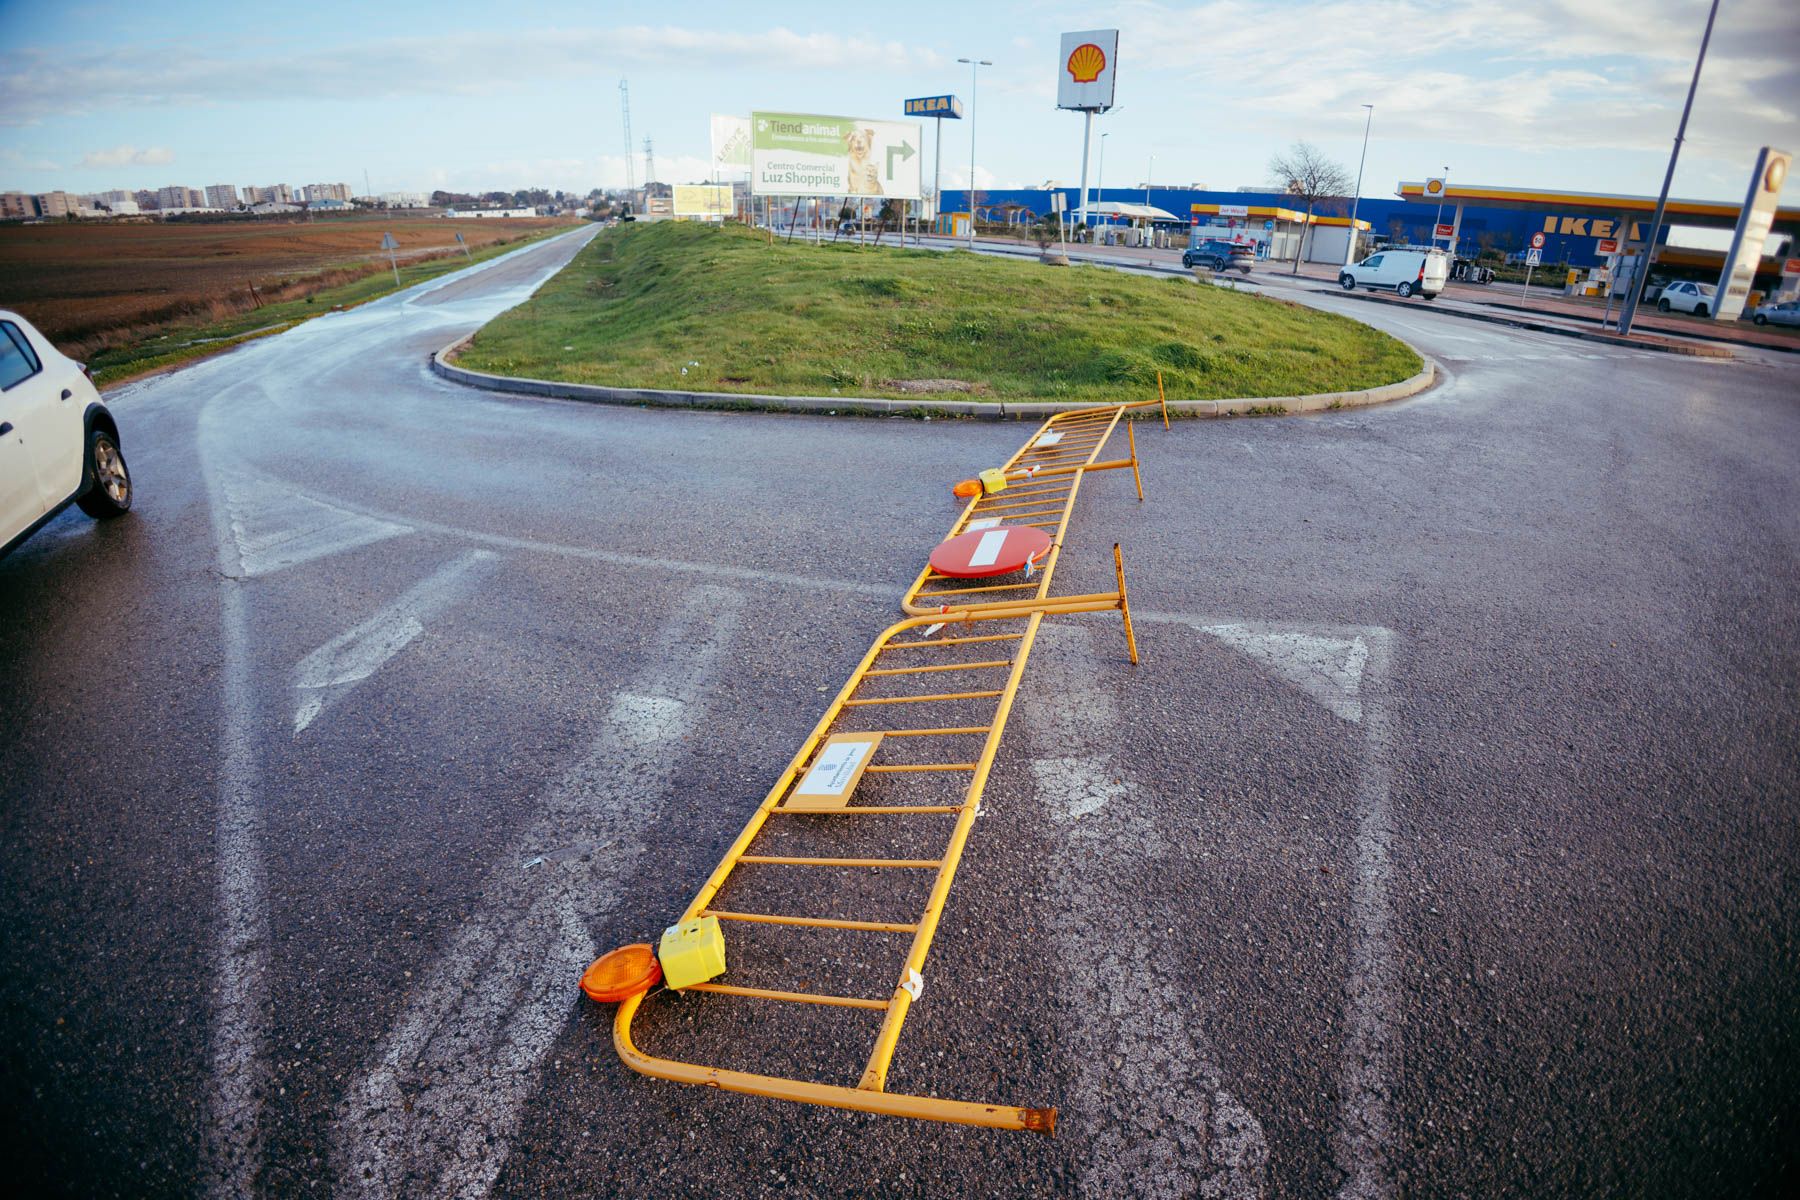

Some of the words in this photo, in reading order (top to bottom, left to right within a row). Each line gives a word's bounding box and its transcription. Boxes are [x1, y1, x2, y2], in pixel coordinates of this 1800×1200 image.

[906, 97, 949, 113] IKEA
[769, 120, 840, 137] Tiendanimal
[767, 161, 795, 170] Centro
[796, 162, 835, 172] Comercial
[762, 171, 783, 183] Luz
[785, 172, 840, 188] Shopping
[1543, 216, 1640, 240] IKEA
